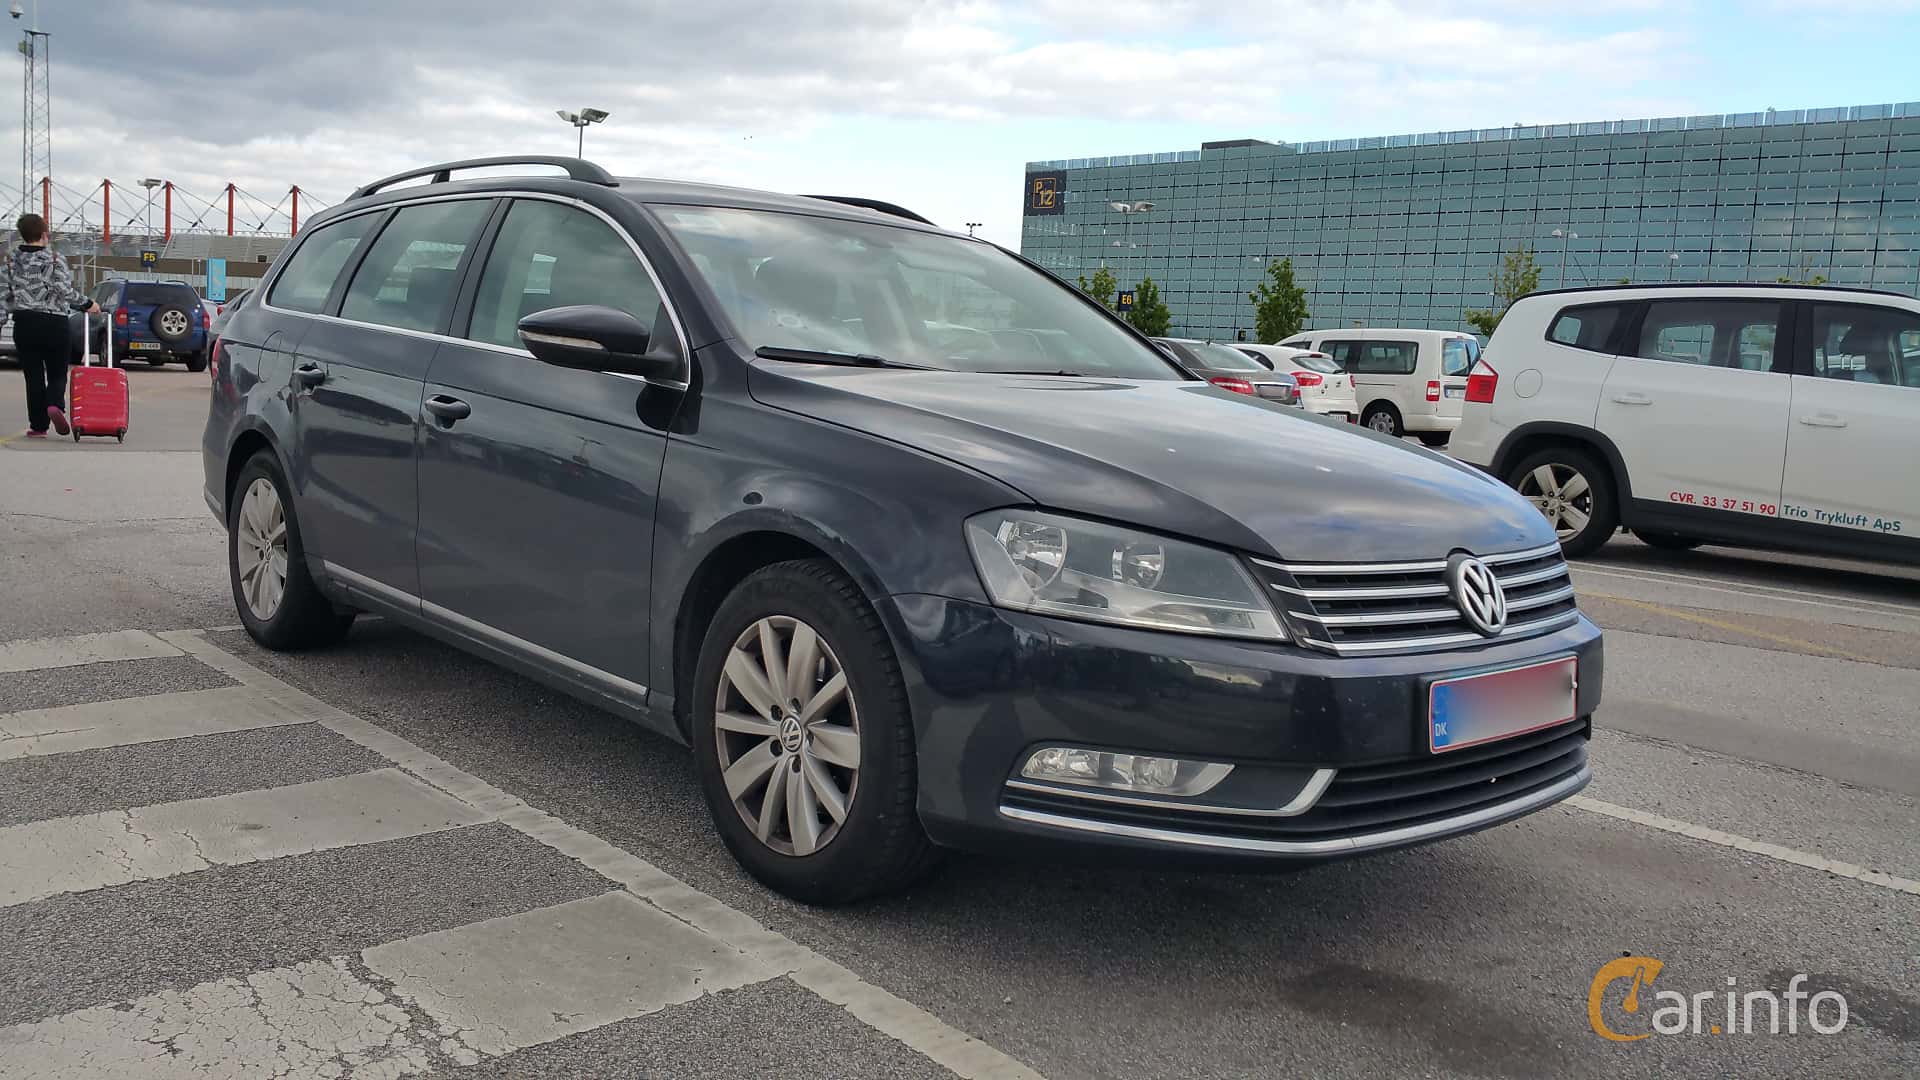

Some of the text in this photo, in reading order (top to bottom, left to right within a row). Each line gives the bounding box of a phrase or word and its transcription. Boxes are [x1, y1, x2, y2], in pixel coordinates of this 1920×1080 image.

[1036, 182, 1043, 193] P
[1040, 190, 1053, 205] 12
[143, 252, 156, 262] F5
[1670, 491, 1776, 515] CVR. 33 37 51 90
[1783, 504, 1901, 533] Trio Trykluft ApS
[1435, 722, 1448, 737] DK
